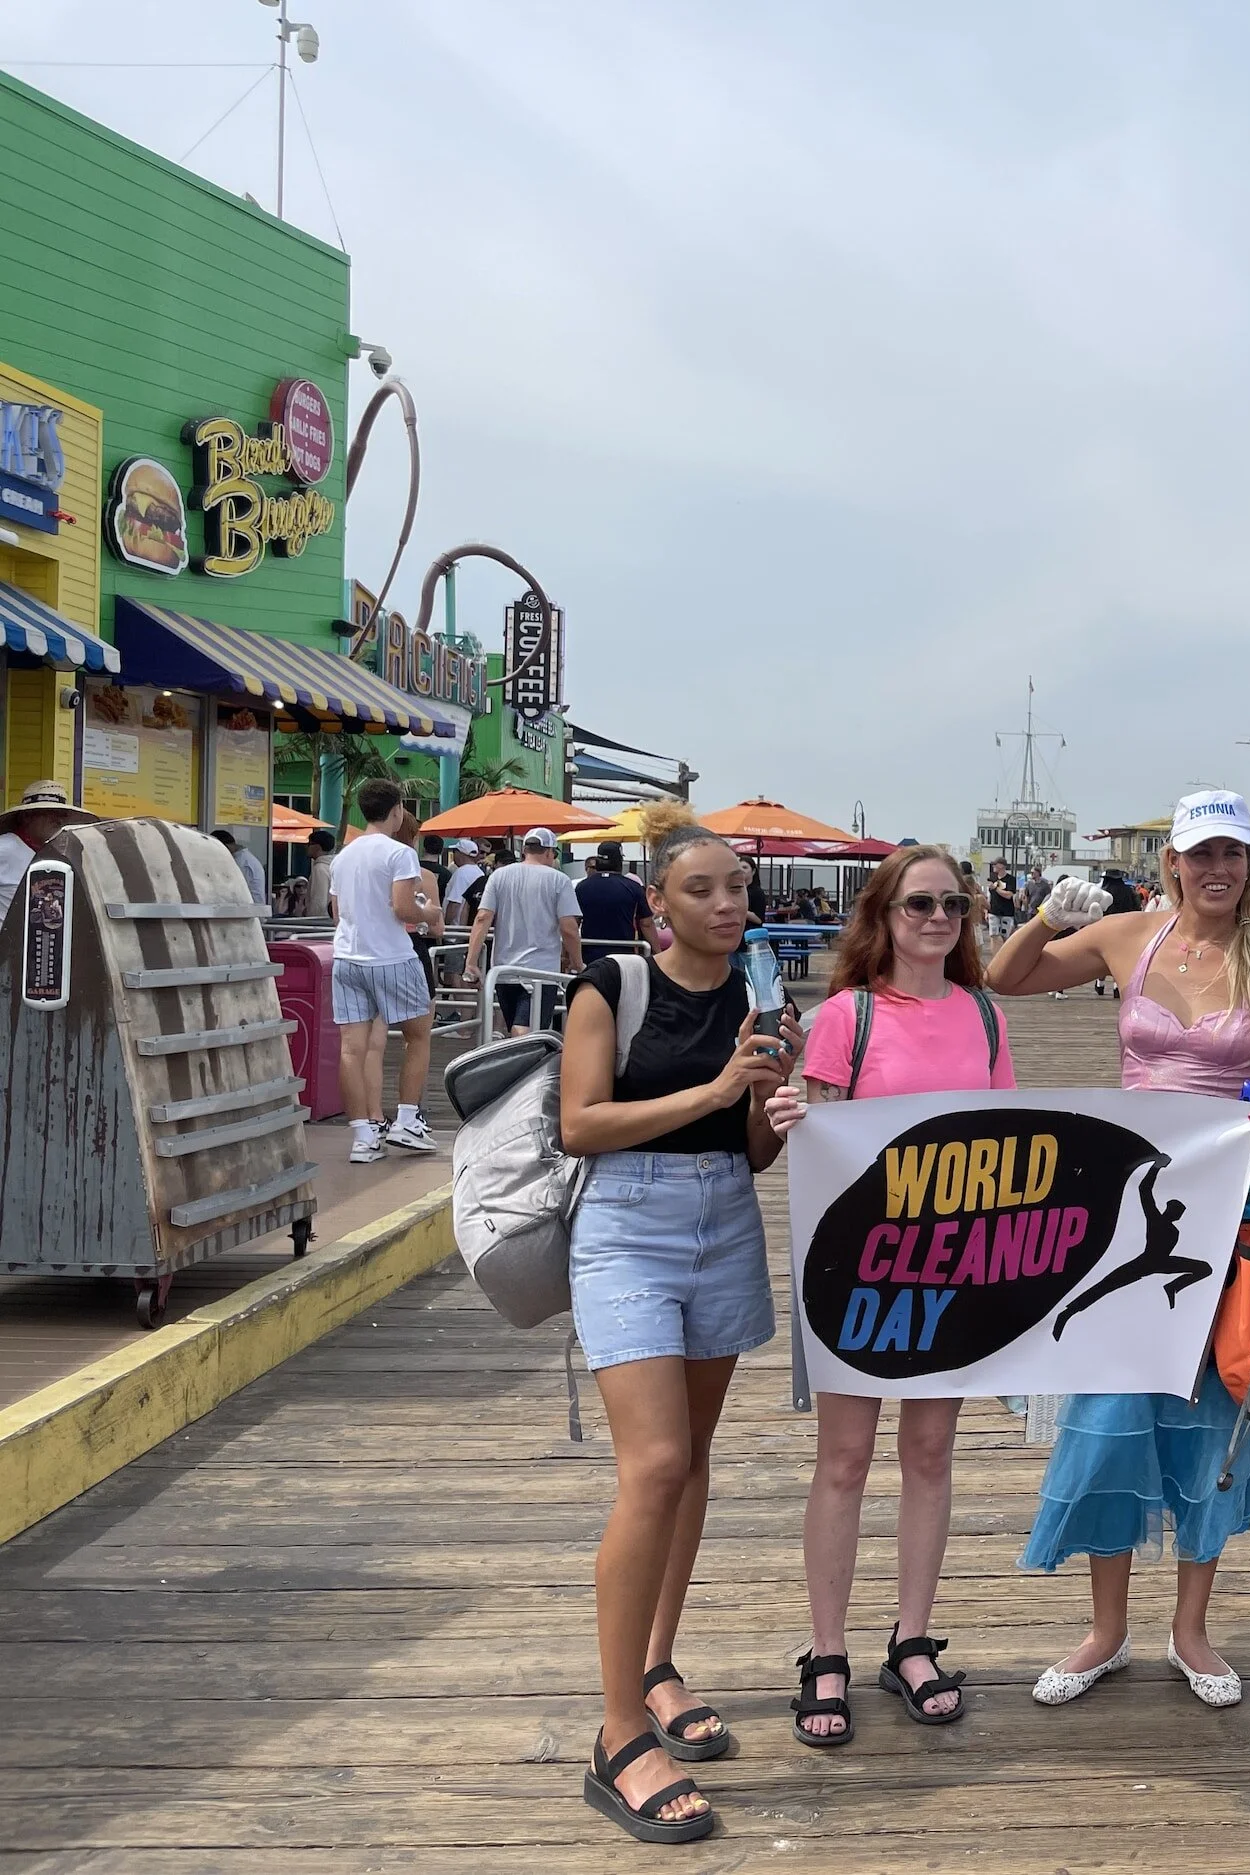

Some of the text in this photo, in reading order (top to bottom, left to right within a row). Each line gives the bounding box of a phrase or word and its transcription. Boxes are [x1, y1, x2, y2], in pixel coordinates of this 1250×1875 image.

[291, 416, 326, 447] ARLIC FRIES
[304, 450, 321, 472] DOGS
[350, 578, 478, 706] PACIFIC
[1190, 803, 1236, 820] ESTONIA
[885, 1134, 1058, 1219] WORLD
[857, 1206, 1089, 1285] CLEANUP
[837, 1288, 957, 1352] DAY
